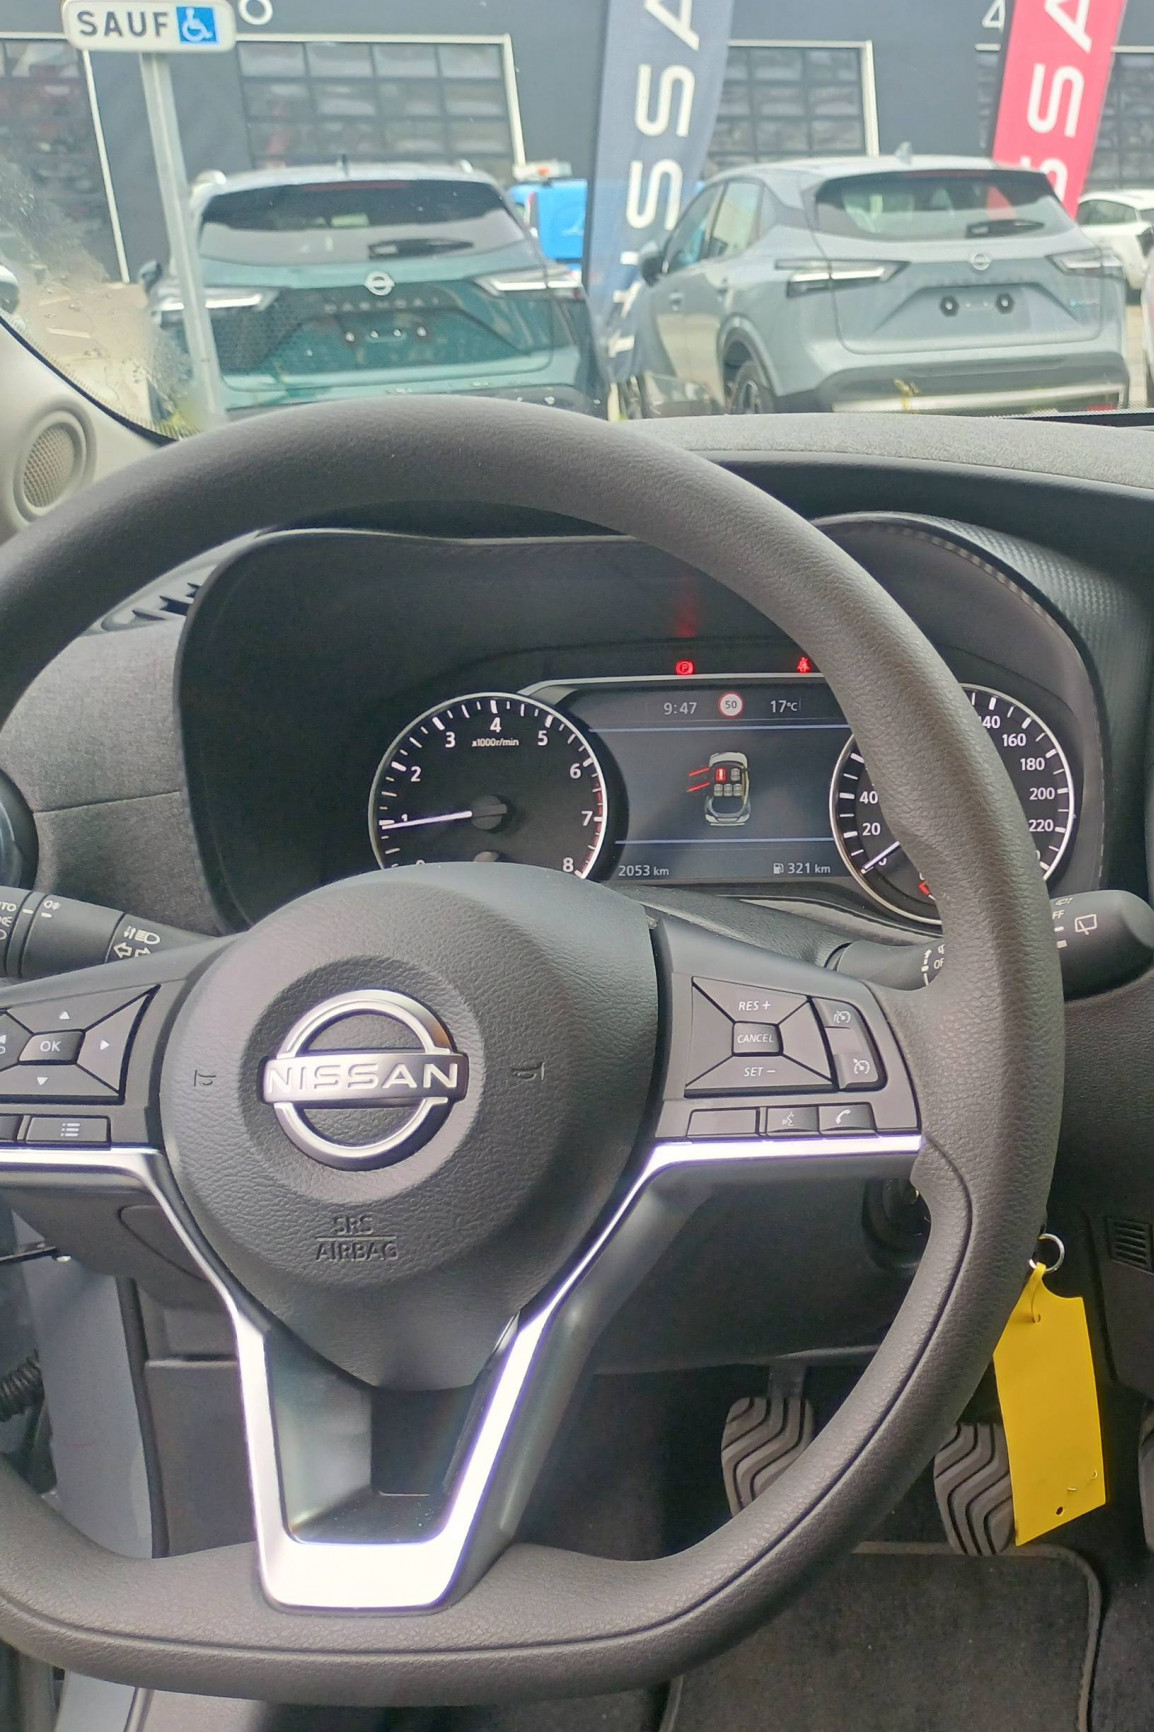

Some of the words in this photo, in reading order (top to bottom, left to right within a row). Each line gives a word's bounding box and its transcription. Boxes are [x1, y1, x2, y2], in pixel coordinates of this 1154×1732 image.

[77, 11, 169, 37] SAUF
[663, 702, 698, 715] 9:47
[725, 701, 738, 710] 50
[489, 717, 501, 733] 4
[445, 731, 456, 748] 3
[472, 738, 519, 748] x1000r/min
[537, 730, 548, 747] 5
[1002, 733, 1027, 747] 160
[569, 763, 581, 779] 6
[1020, 757, 1045, 771] 180
[410, 766, 422, 782] 2
[859, 791, 878, 804] 40
[1029, 787, 1056, 800] 200
[581, 810, 593, 826] 7
[862, 822, 881, 836] 20
[1028, 819, 1055, 832] 220
[562, 858, 574, 872] 8
[618, 865, 651, 877] 2053
[653, 866, 670, 876] km
[787, 862, 812, 875] 321
[814, 863, 832, 874] km
[738, 1000, 760, 1011] RES
[737, 1033, 775, 1044] CANCEL
[40, 1040, 62, 1053] OK
[267, 1062, 459, 1094] NISSAN
[743, 1066, 764, 1077] SET
[333, 1215, 374, 1235] SRS
[315, 1242, 399, 1262] AIRBAG
